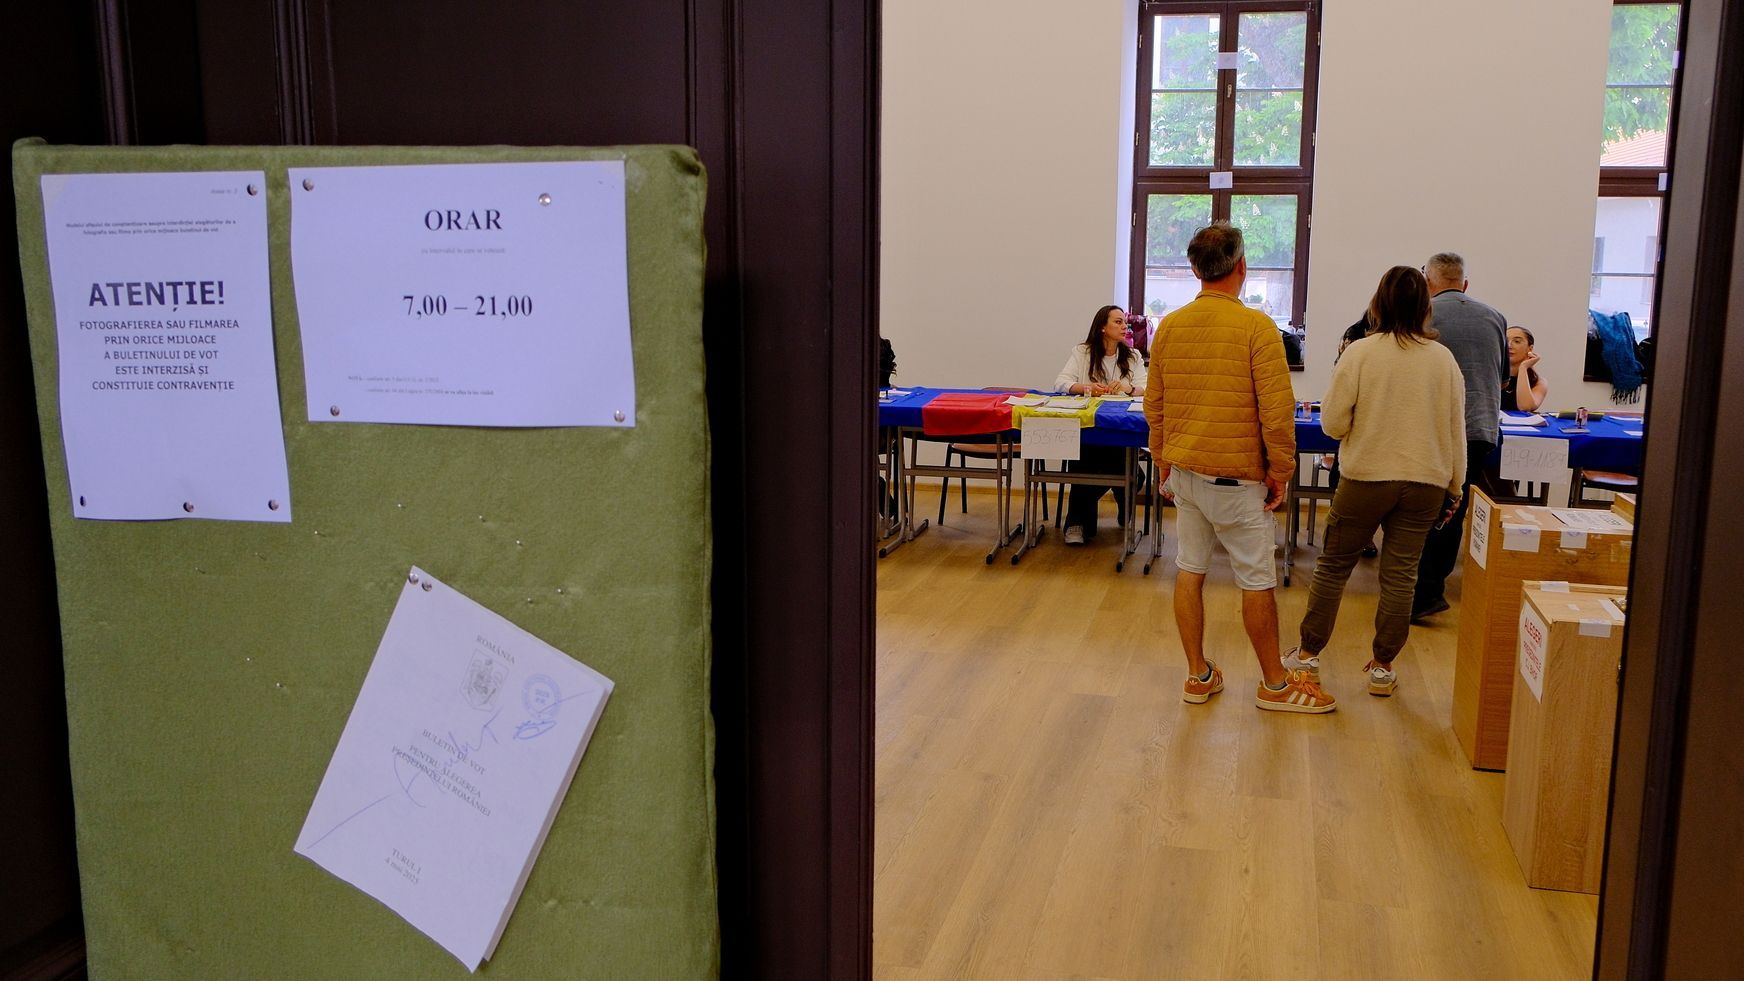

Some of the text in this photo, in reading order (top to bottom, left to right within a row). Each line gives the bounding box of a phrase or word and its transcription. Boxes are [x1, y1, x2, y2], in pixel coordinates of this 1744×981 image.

[424, 208, 503, 231] ORAR
[89, 280, 225, 313] ATENȚIE!
[402, 294, 448, 320] 7,00
[474, 294, 533, 320] 21,00
[79, 319, 240, 330] FOTOGRAFIEREA SAU FILMAREA
[104, 335, 217, 345] PRIN ORICE MIJLOACE
[104, 350, 219, 360] A BULETINULUI DE VOT
[115, 366, 139, 375] ESTE
[142, 363, 195, 375] INTERZISĂ
[92, 380, 235, 392] CONSTITUIE CONTRAVENȚIE
[476, 634, 515, 664] ROMÂNIA
[422, 729, 457, 755] BULETIN
[469, 759, 486, 776] VOT
[409, 744, 481, 798] PENTRU ALEGEREA
